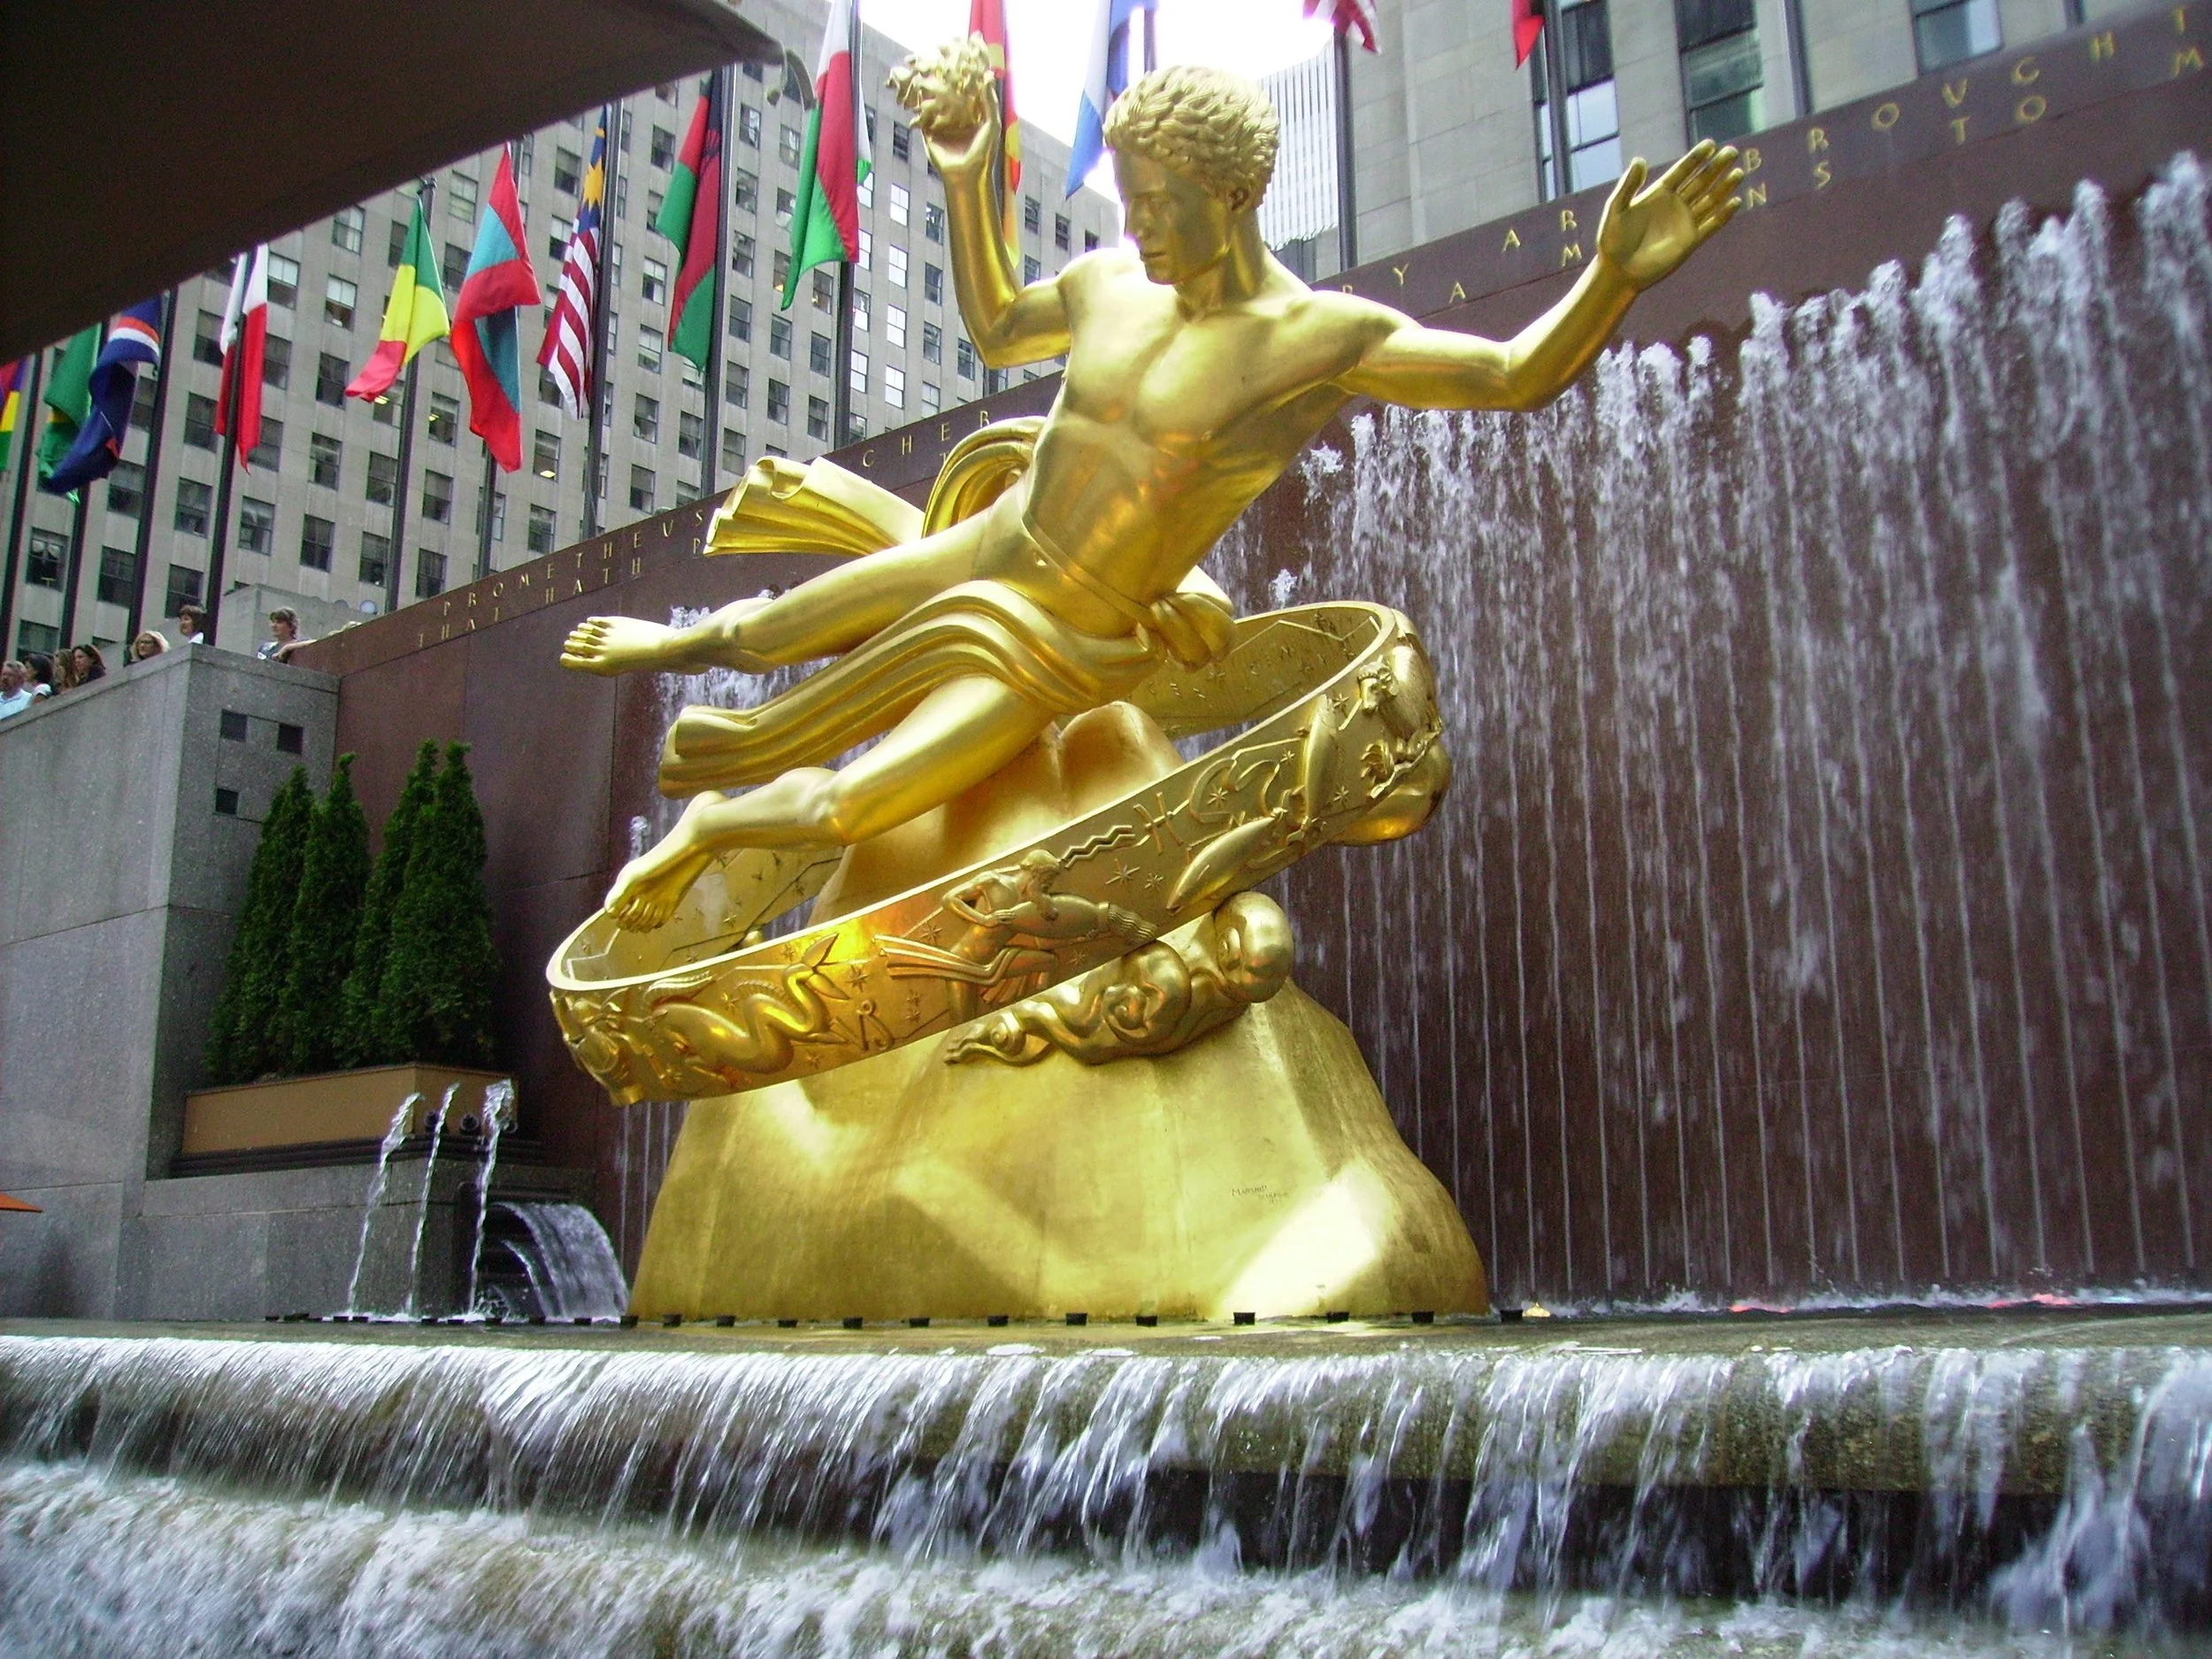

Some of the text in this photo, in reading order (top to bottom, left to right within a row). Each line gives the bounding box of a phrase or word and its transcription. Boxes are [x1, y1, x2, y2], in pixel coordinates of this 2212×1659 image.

[418, 607, 500, 649] THAT
[545, 557, 641, 604] HATH
[1562, 160, 1832, 268] MNS
[1950, 95, 2047, 146] TO
[862, 411, 991, 467] CHER
